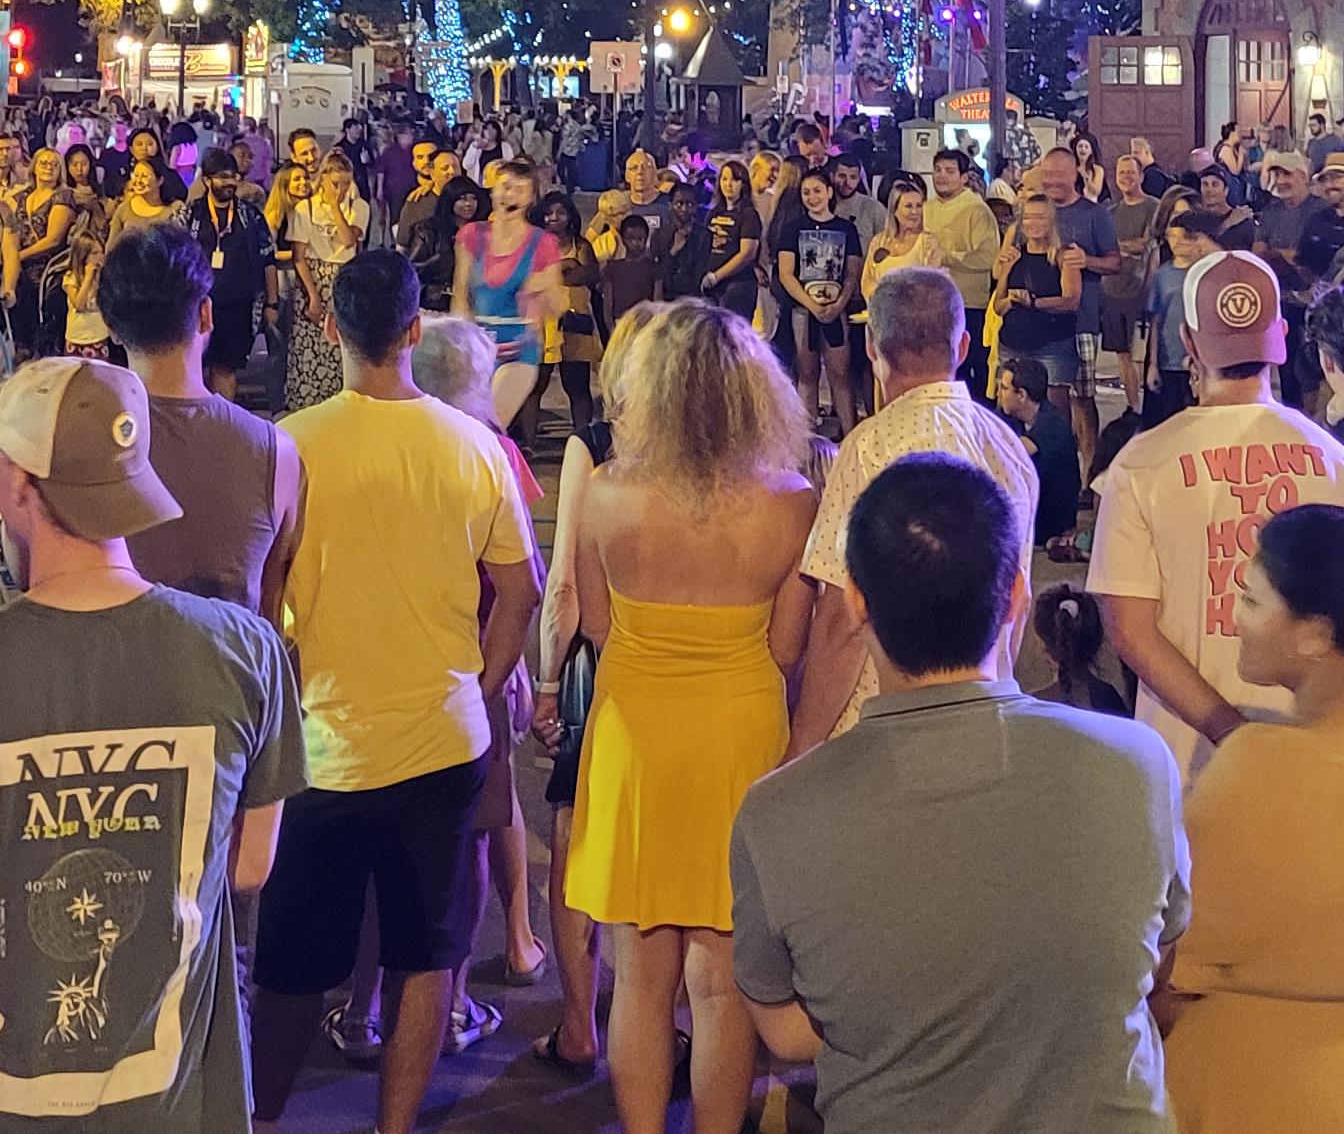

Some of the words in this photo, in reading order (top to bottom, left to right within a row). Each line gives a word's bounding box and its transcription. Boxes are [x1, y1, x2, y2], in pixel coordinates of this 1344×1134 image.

[1179, 454, 1197, 488] I
[1202, 443, 1327, 485] WANT
[1230, 475, 1299, 515] TO
[27, 783, 159, 832] NYC
